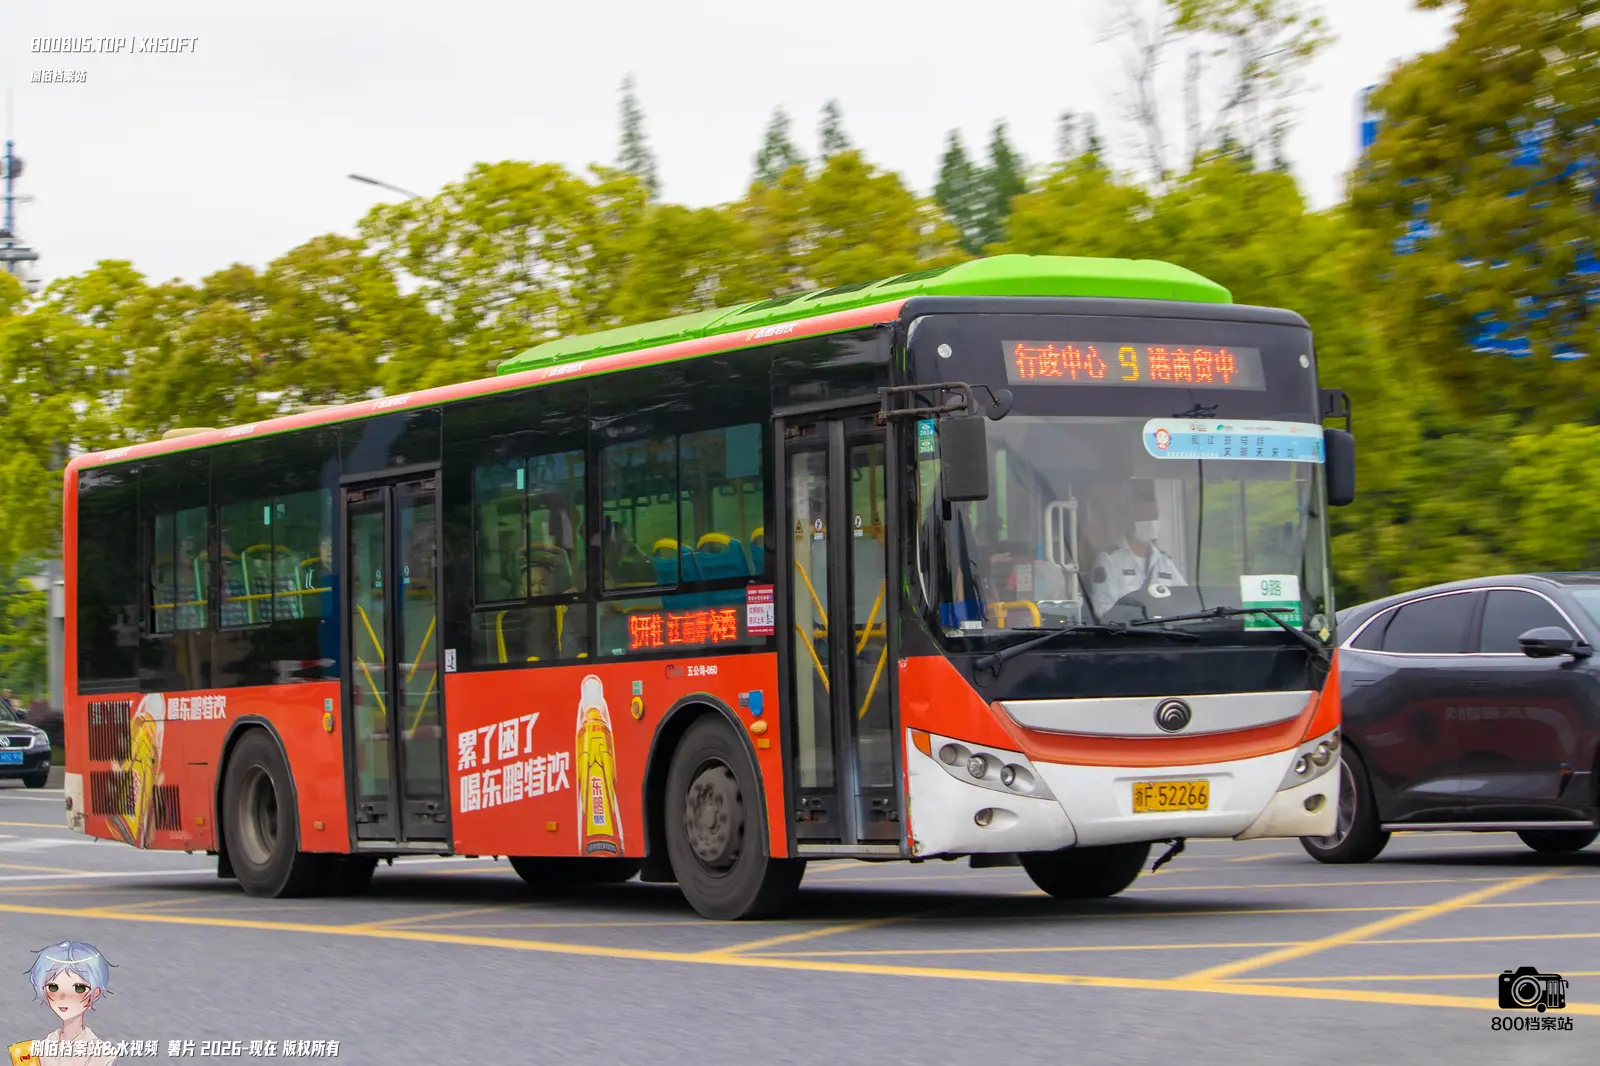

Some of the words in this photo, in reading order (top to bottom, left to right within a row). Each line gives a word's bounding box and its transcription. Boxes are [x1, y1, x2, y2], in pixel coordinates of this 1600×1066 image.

[1014, 343, 1107, 380] 行政中心
[1117, 346, 1140, 381] 9
[1260, 579, 1282, 597] 9路
[457, 711, 540, 771] 累了困了
[459, 751, 570, 813] 喝东鹏特饮
